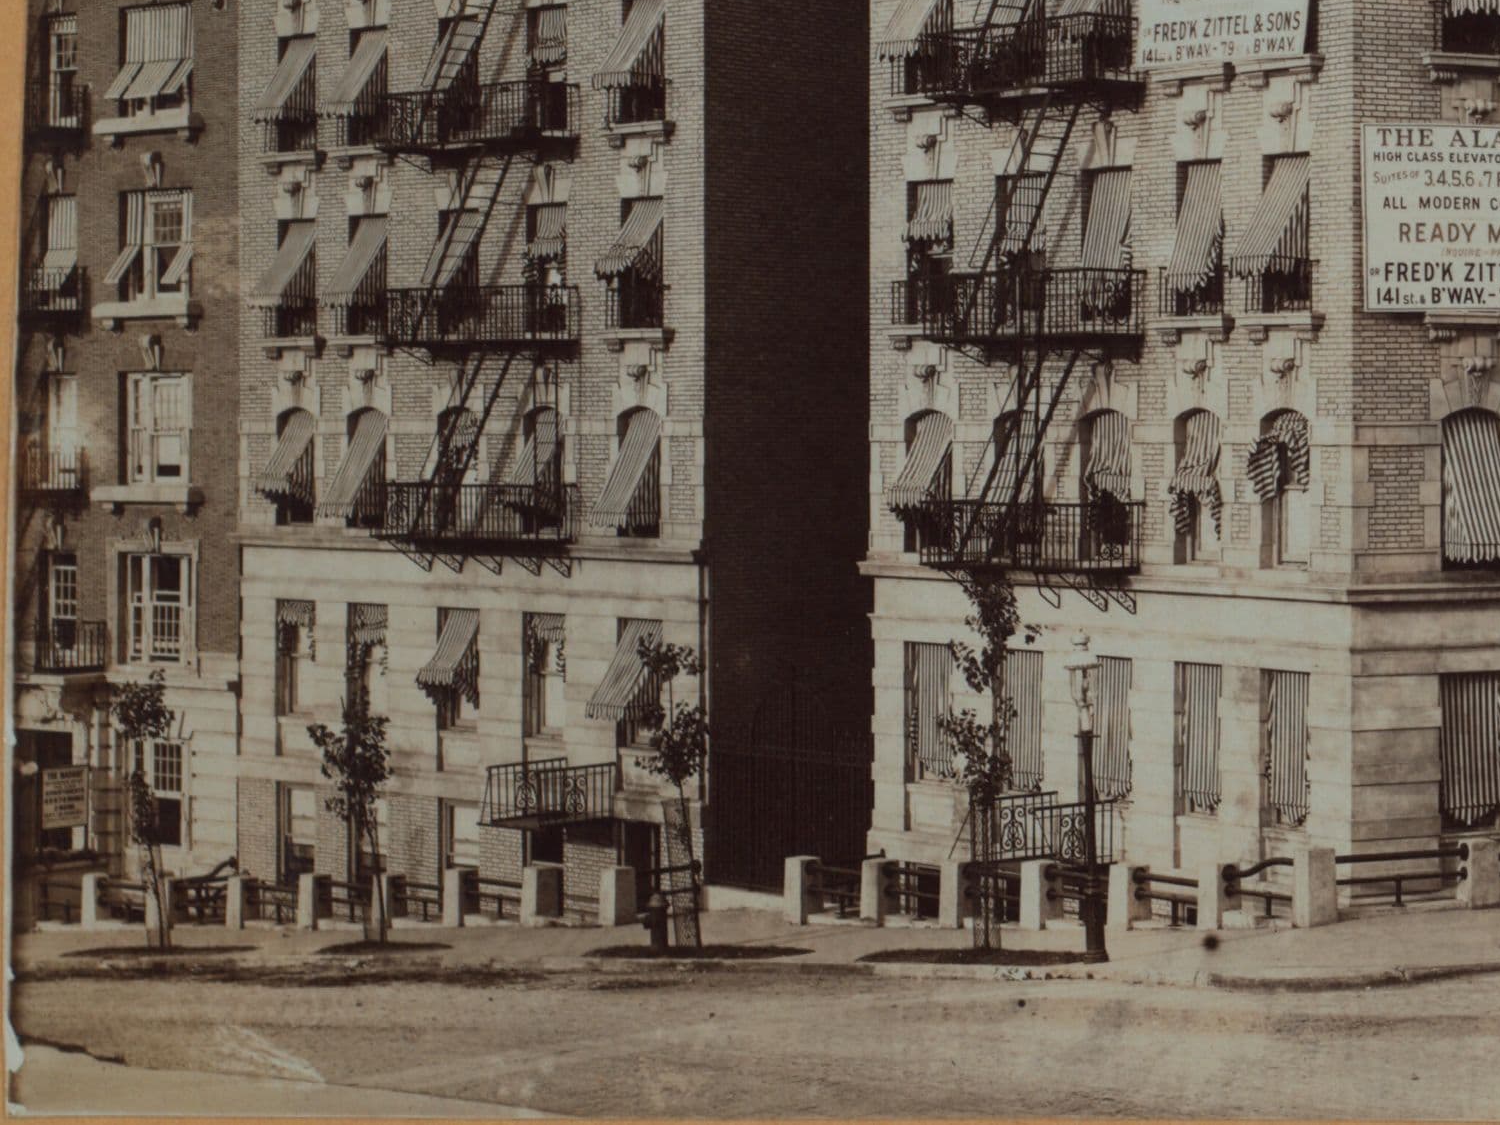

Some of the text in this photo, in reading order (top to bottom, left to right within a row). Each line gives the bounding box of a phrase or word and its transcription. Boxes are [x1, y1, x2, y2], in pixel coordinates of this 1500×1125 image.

[1153, 19, 1198, 43] FRED'K
[1202, 14, 1250, 38] ZITTEL
[1253, 13, 1264, 34] &
[1266, 10, 1301, 32] SONS
[1376, 128, 1434, 147] THE
[1373, 151, 1402, 162] HIGH
[1406, 151, 1444, 163] CLASS
[1383, 196, 1408, 210] ALL
[1419, 195, 1480, 210] MODERN
[1399, 222, 1476, 243] READY
[1369, 267, 1380, 276] OR
[1384, 262, 1453, 282] FRED'K
